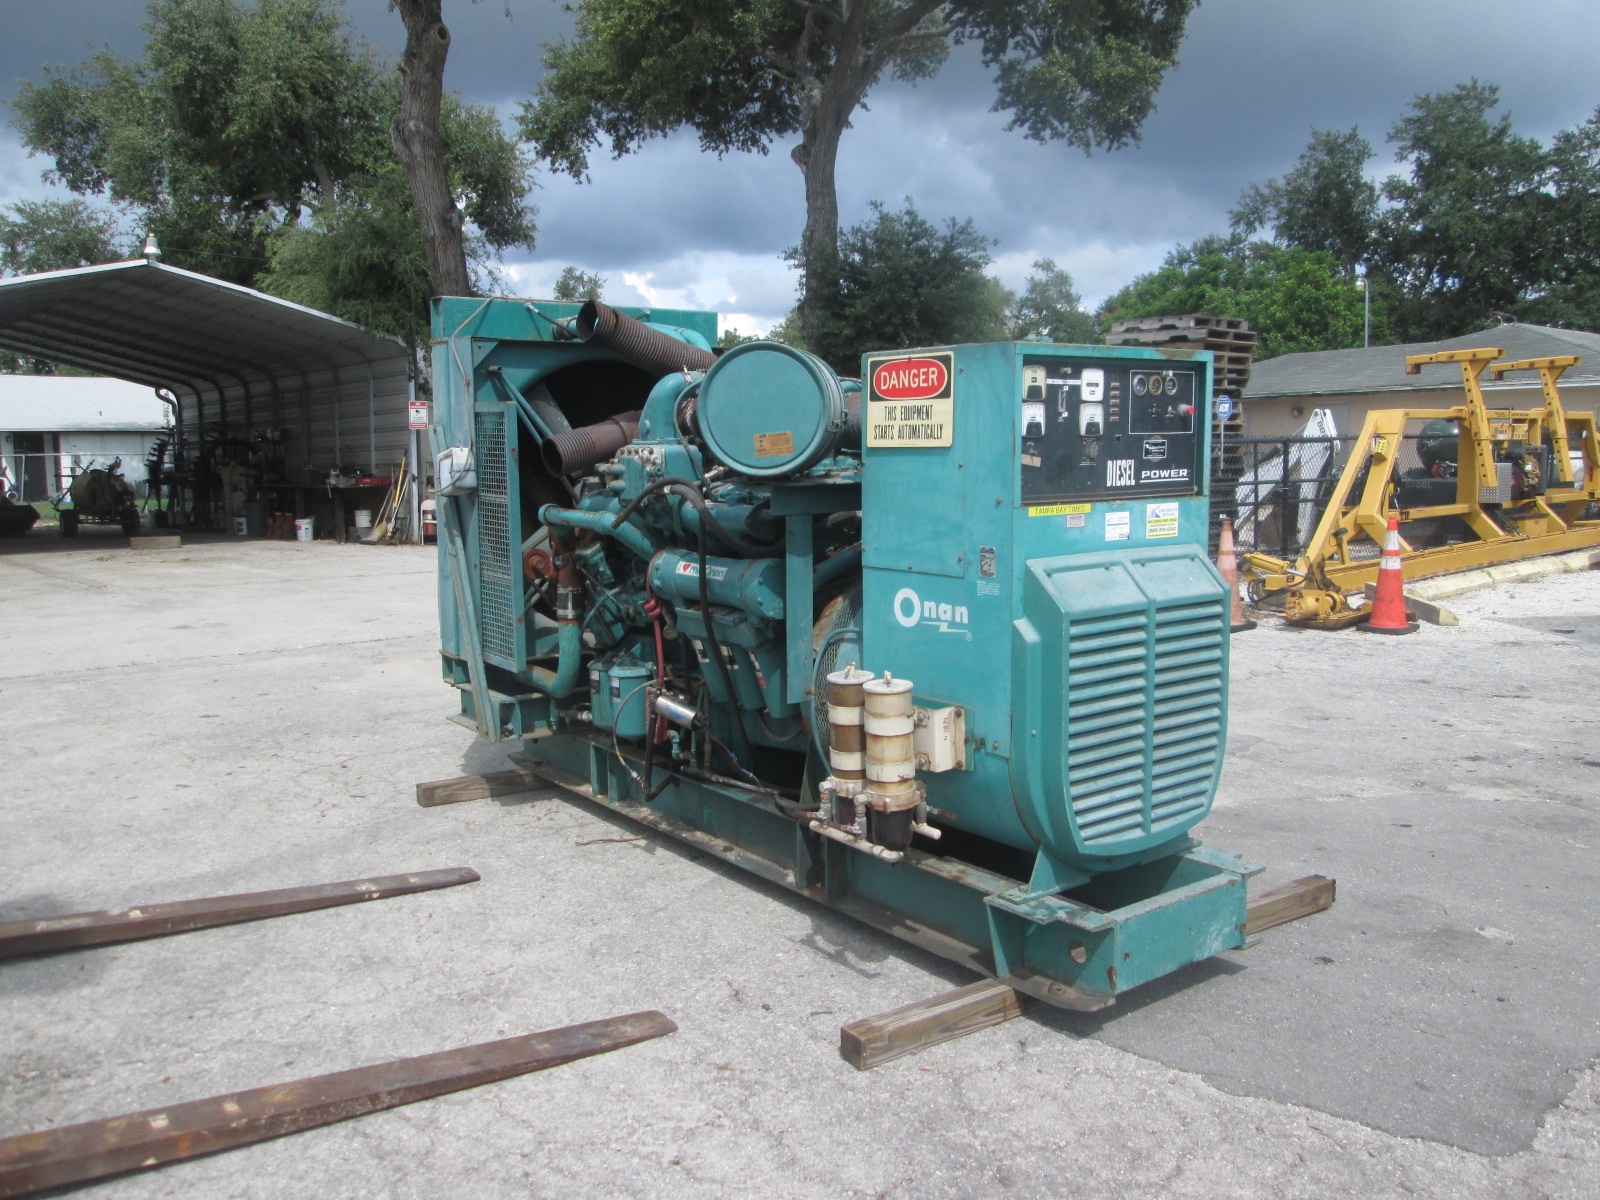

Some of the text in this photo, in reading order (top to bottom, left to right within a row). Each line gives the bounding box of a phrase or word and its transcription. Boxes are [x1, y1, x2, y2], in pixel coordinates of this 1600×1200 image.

[881, 367, 938, 390] DANGER
[884, 404, 934, 421] THIS EQUIPMENT
[873, 423, 944, 440] STARTS AUTOMATICALLY
[1106, 459, 1188, 487] DIESEL POWER
[1035, 504, 1085, 515] TAMPA BAY TIMES
[893, 587, 969, 628] Onan
